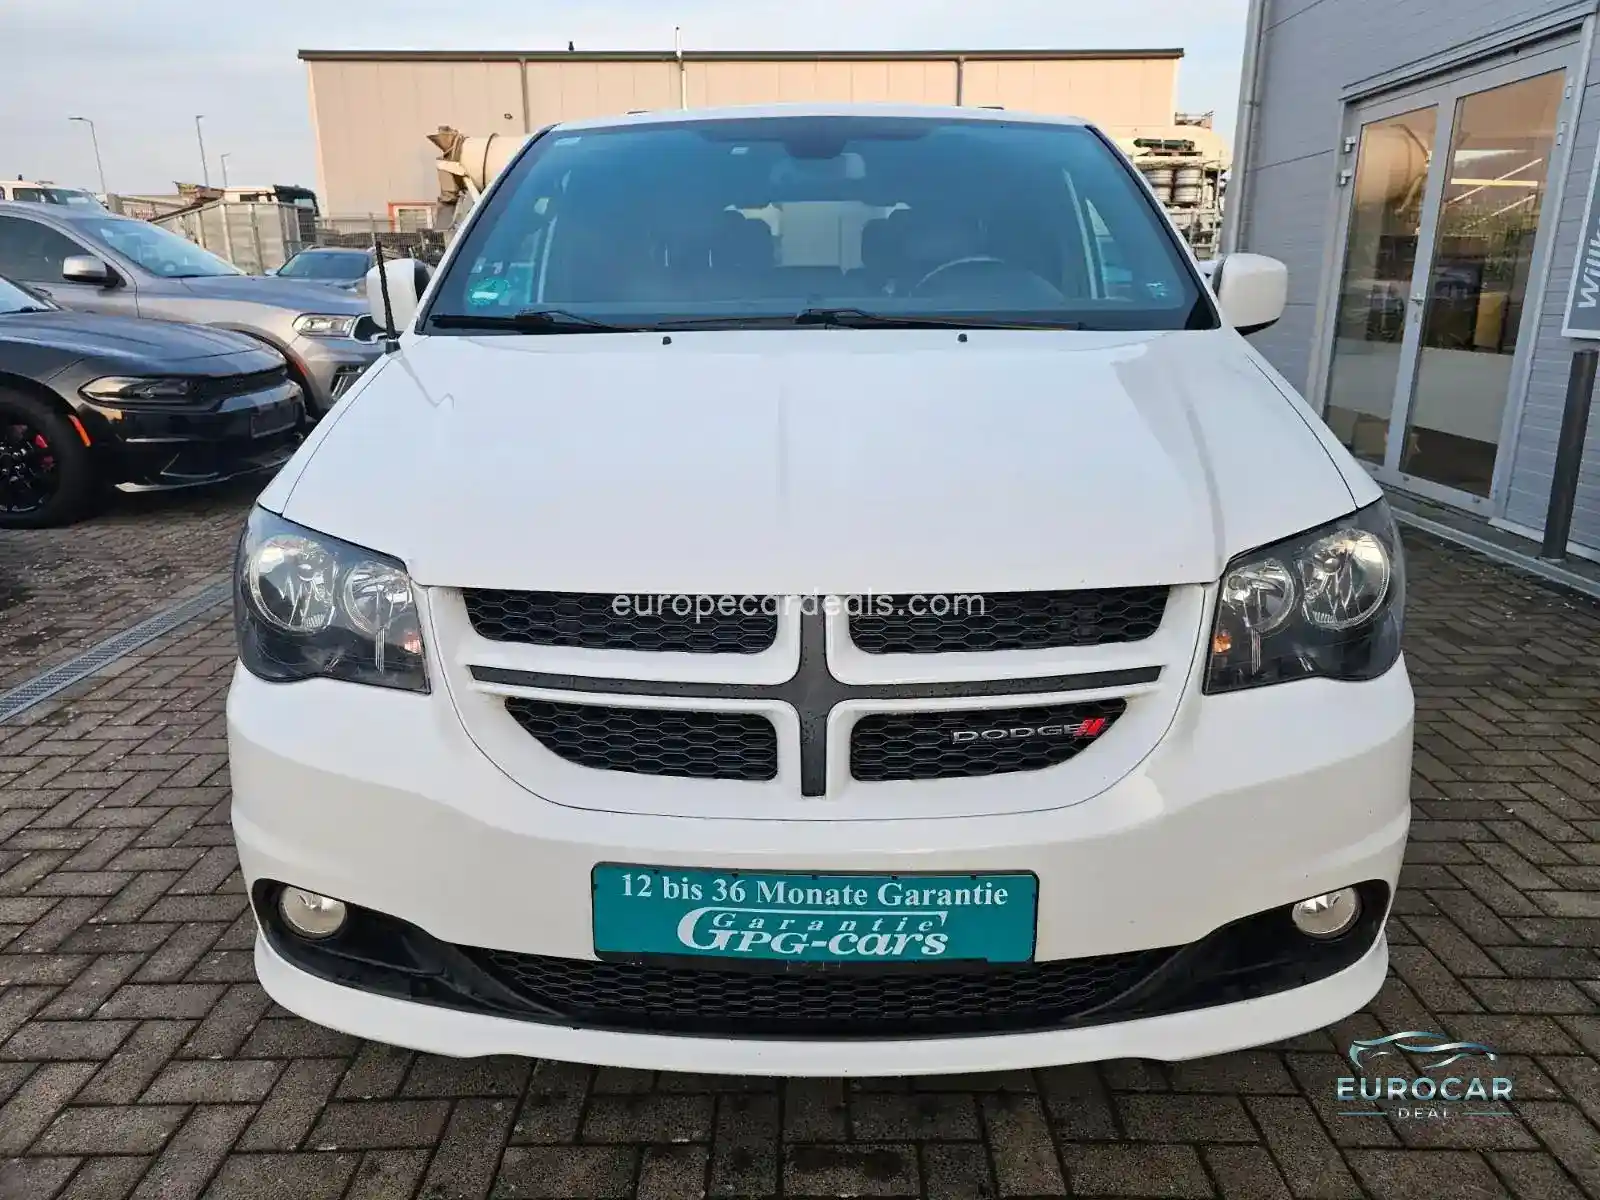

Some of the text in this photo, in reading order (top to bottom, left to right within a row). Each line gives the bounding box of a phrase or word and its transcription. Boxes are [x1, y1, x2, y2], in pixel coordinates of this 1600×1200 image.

[952, 722, 1082, 742] DODGE
[622, 873, 1009, 908] 12 bis 36 Monate Garantie
[712, 911, 935, 932] Garantie
